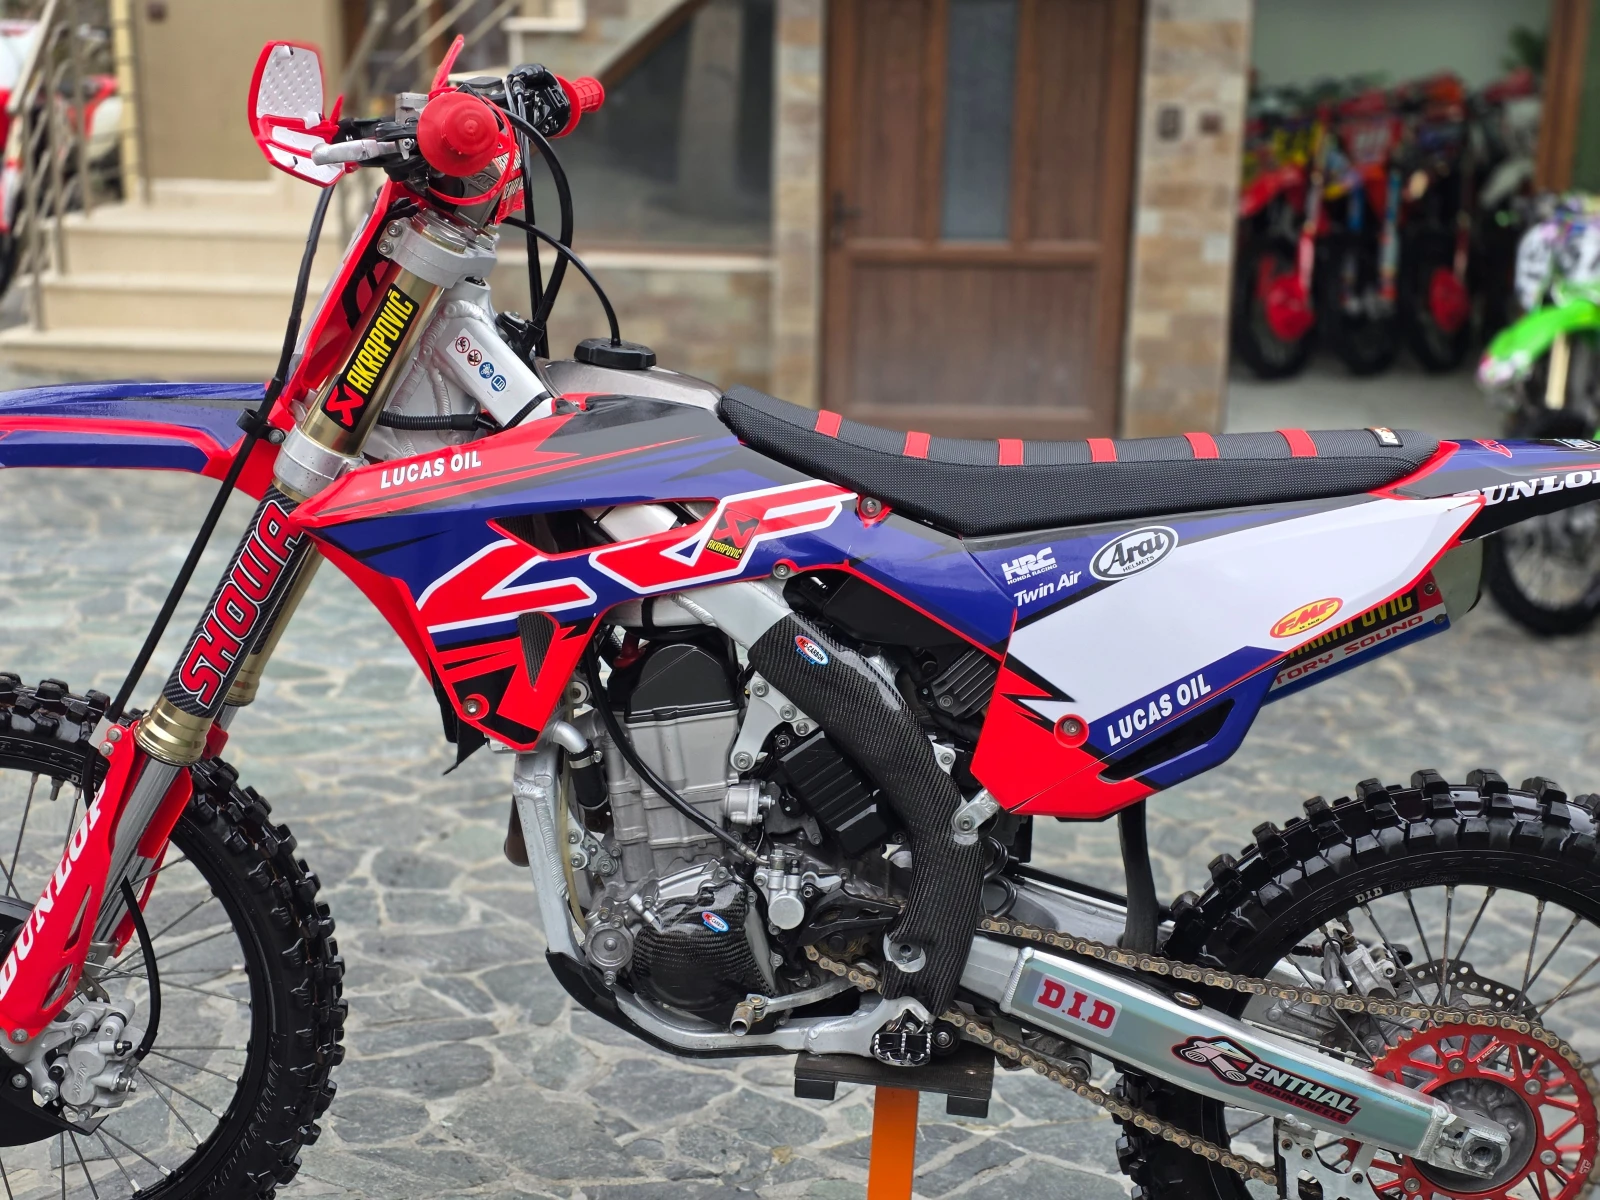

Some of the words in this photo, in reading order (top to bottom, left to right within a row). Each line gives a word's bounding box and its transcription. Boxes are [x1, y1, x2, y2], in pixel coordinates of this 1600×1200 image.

[380, 457, 445, 489] LUCAS
[450, 450, 482, 472] OIL
[1453, 469, 1600, 507] UNLO
[1001, 546, 1056, 581] HRC
[1102, 531, 1165, 573] Arai
[1122, 555, 1155, 573] HELMETS
[1007, 574, 1032, 585] HONDA
[1031, 563, 1058, 576] RACING
[1013, 582, 1055, 607] Twin
[1056, 570, 1082, 591] Air
[179, 500, 304, 709] SHOWA
[1276, 599, 1339, 635] FMF
[1276, 653, 1334, 685] TORY
[1344, 615, 1424, 655] SOUND
[1107, 693, 1173, 747] LUCAS
[1176, 673, 1212, 706] OIL
[1037, 978, 1116, 1030] D.I.D
[1253, 1082, 1349, 1122] CHAINWHEELS
